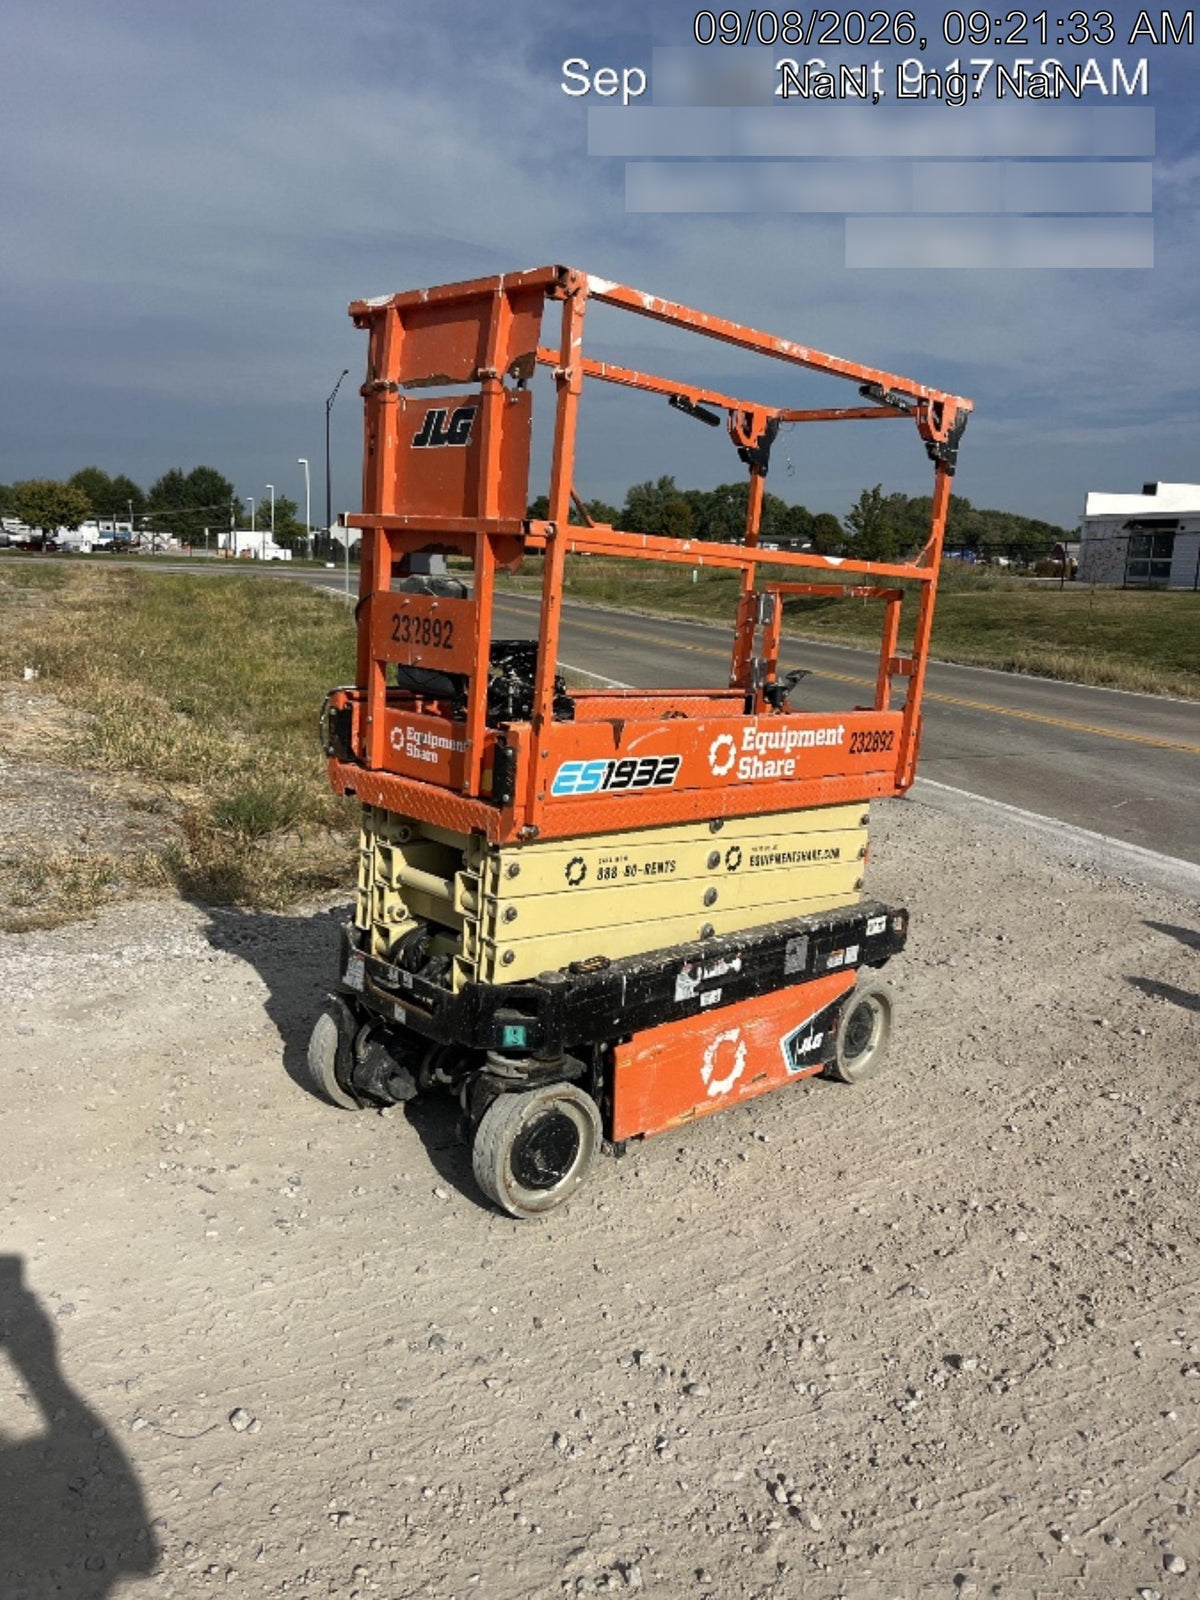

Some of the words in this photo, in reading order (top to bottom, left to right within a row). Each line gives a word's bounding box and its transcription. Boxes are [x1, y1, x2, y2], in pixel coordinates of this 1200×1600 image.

[410, 406, 478, 449] JLG
[741, 725, 845, 755] Equipment
[849, 730, 894, 754] 232892
[551, 755, 682, 796] ES1932
[736, 756, 796, 779] Share
